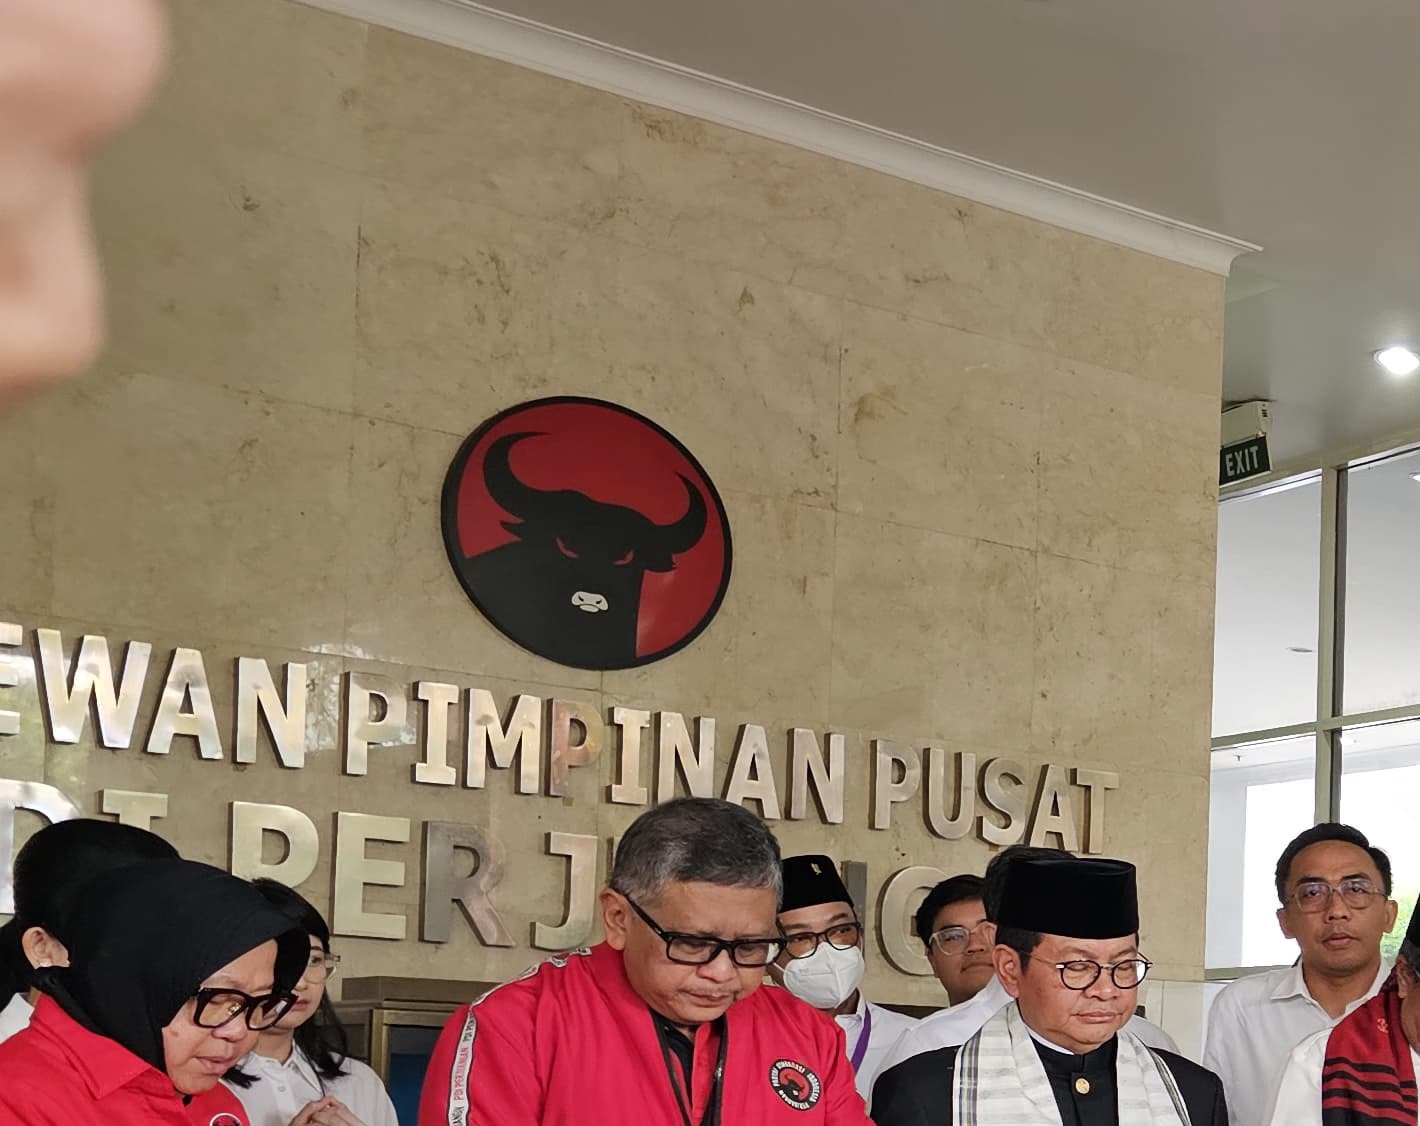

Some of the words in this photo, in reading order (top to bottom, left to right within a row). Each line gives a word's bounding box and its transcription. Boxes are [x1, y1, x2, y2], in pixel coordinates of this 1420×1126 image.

[1225, 445, 1258, 477] EXIT
[345, 671, 845, 823] PIMPINAN
[869, 738, 1119, 854] PUSAT
